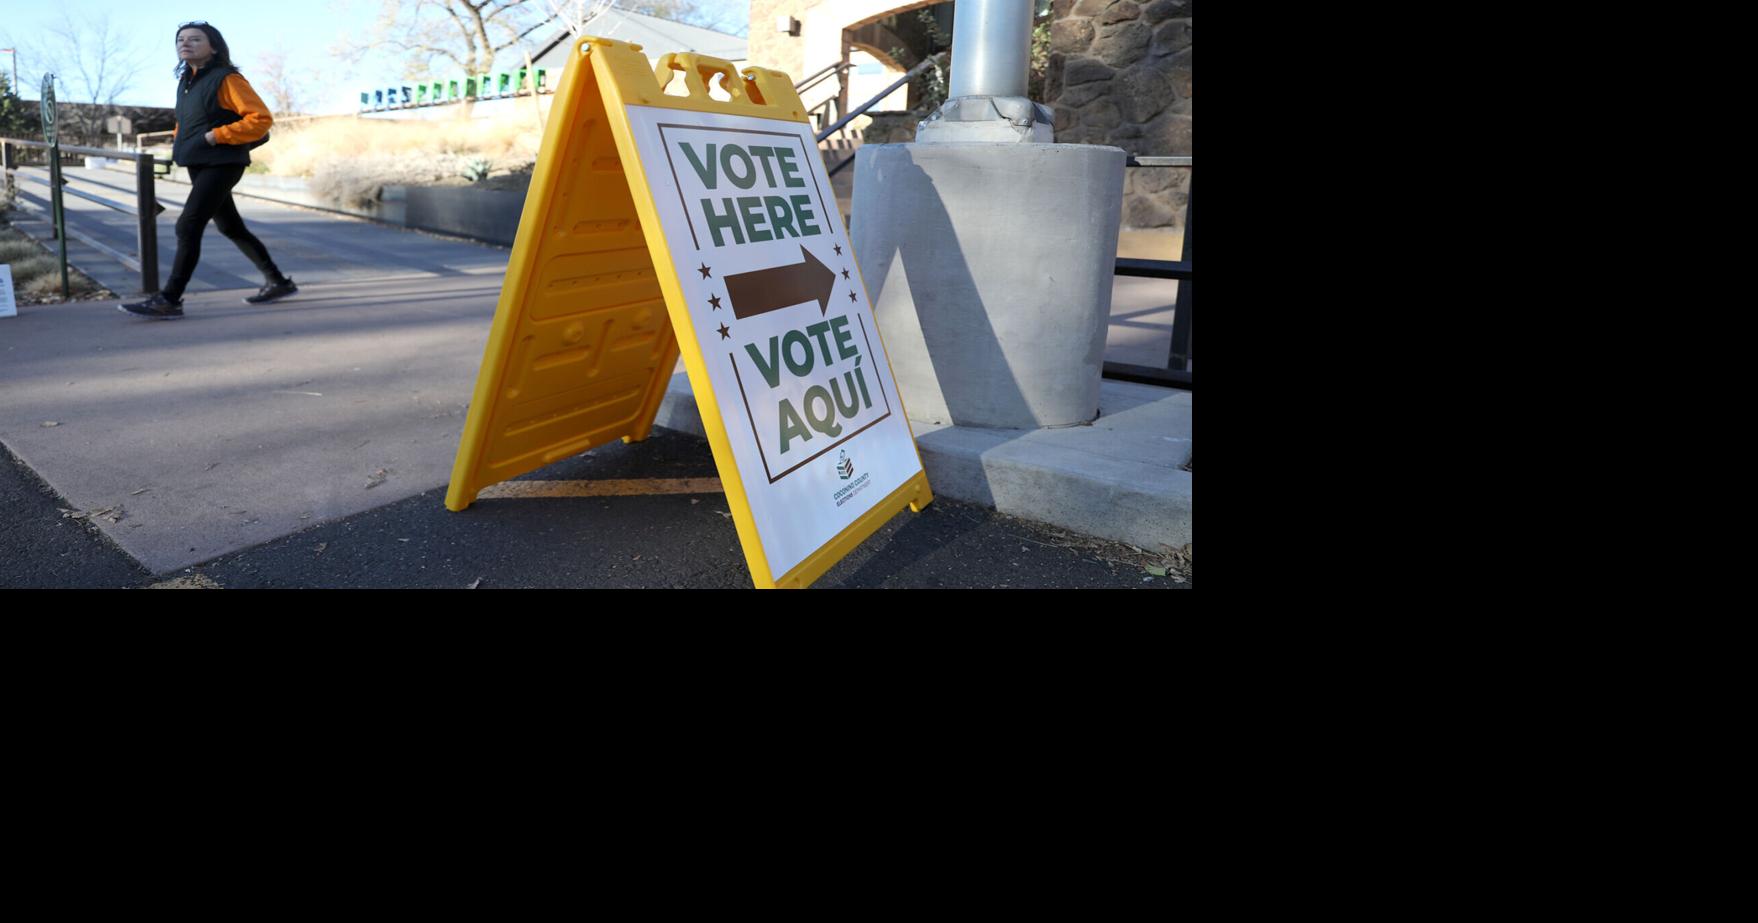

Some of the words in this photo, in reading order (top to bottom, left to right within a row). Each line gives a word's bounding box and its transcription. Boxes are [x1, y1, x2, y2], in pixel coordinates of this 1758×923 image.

[678, 142, 806, 190] VOTE
[700, 194, 822, 248] HERE
[744, 315, 859, 389] VOTE
[779, 355, 873, 455] AQUÍ
[833, 483, 855, 501] COCONINO
[854, 472, 869, 486] COUNTY
